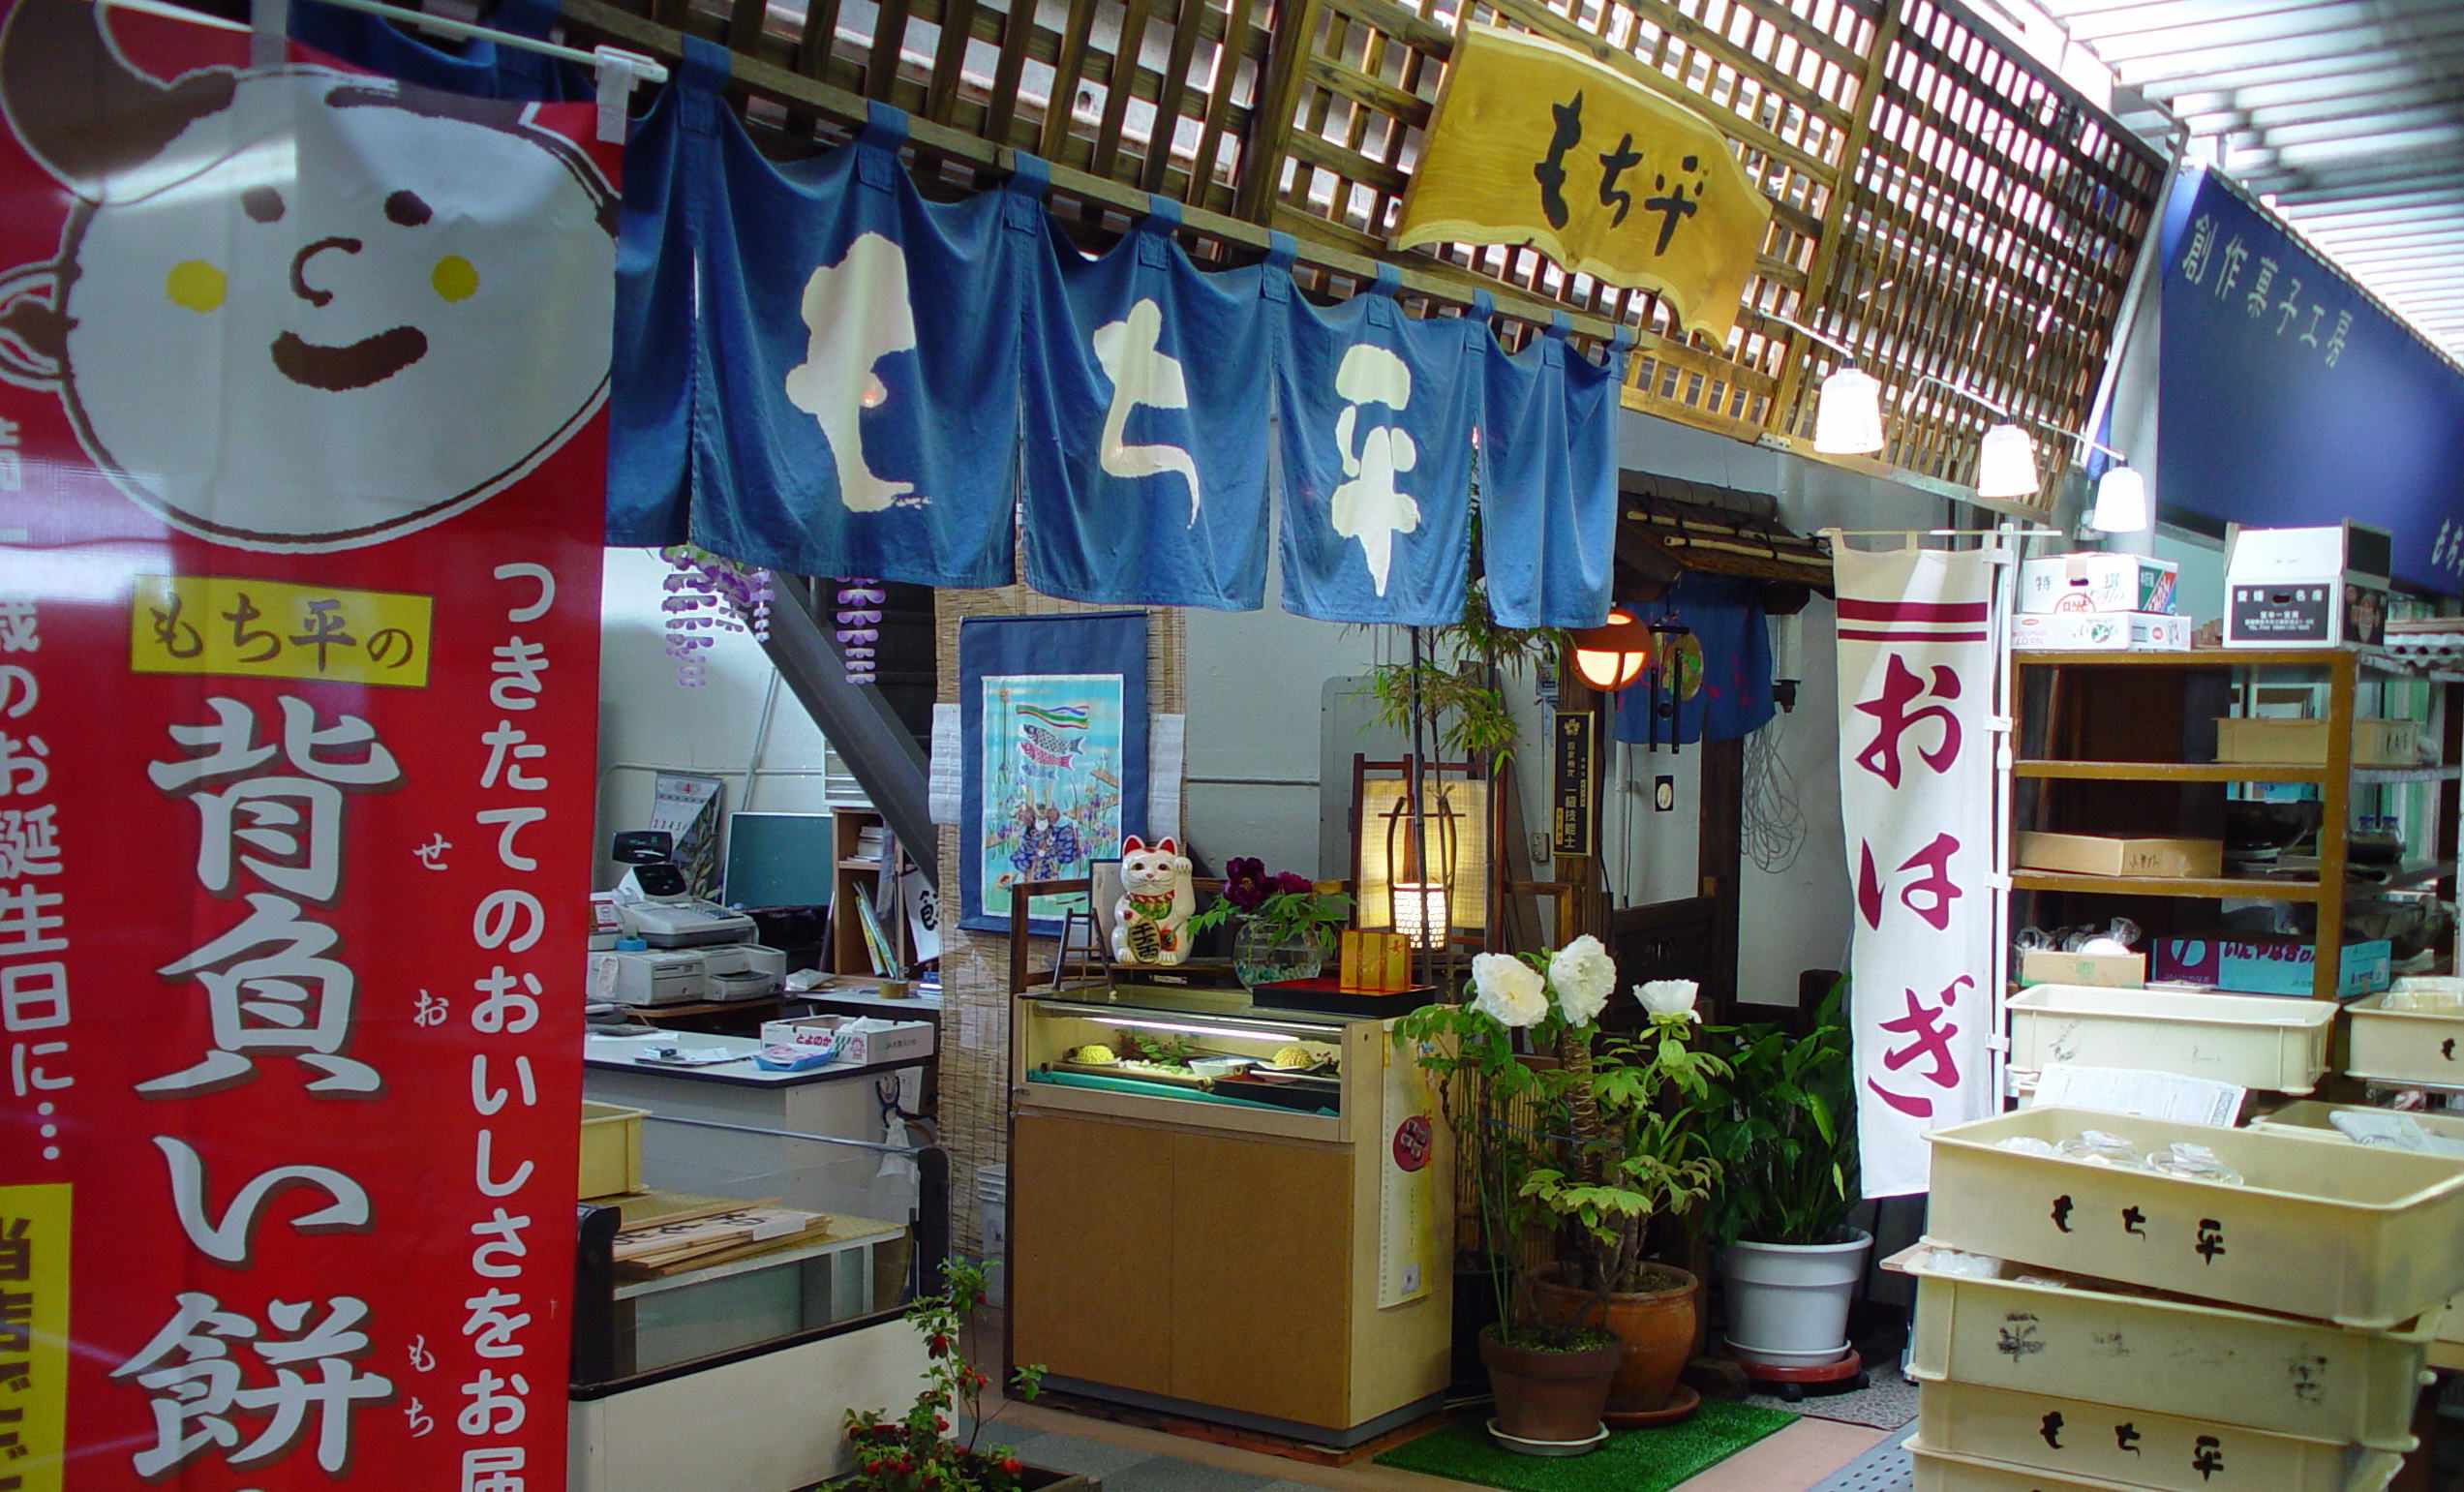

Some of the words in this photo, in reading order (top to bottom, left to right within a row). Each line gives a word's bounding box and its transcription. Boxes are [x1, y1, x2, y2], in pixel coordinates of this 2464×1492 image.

[150, 592, 413, 672] もち平の
[413, 834, 451, 871] せ
[1854, 653, 1976, 1118] おはぎ
[412, 989, 449, 1027] お
[457, 563, 556, 1492] つきたてのおいしさをお届
[796, 1033, 833, 1047] とよのか
[108, 695, 407, 1492] 背負い餅
[404, 1334, 436, 1437] もち
